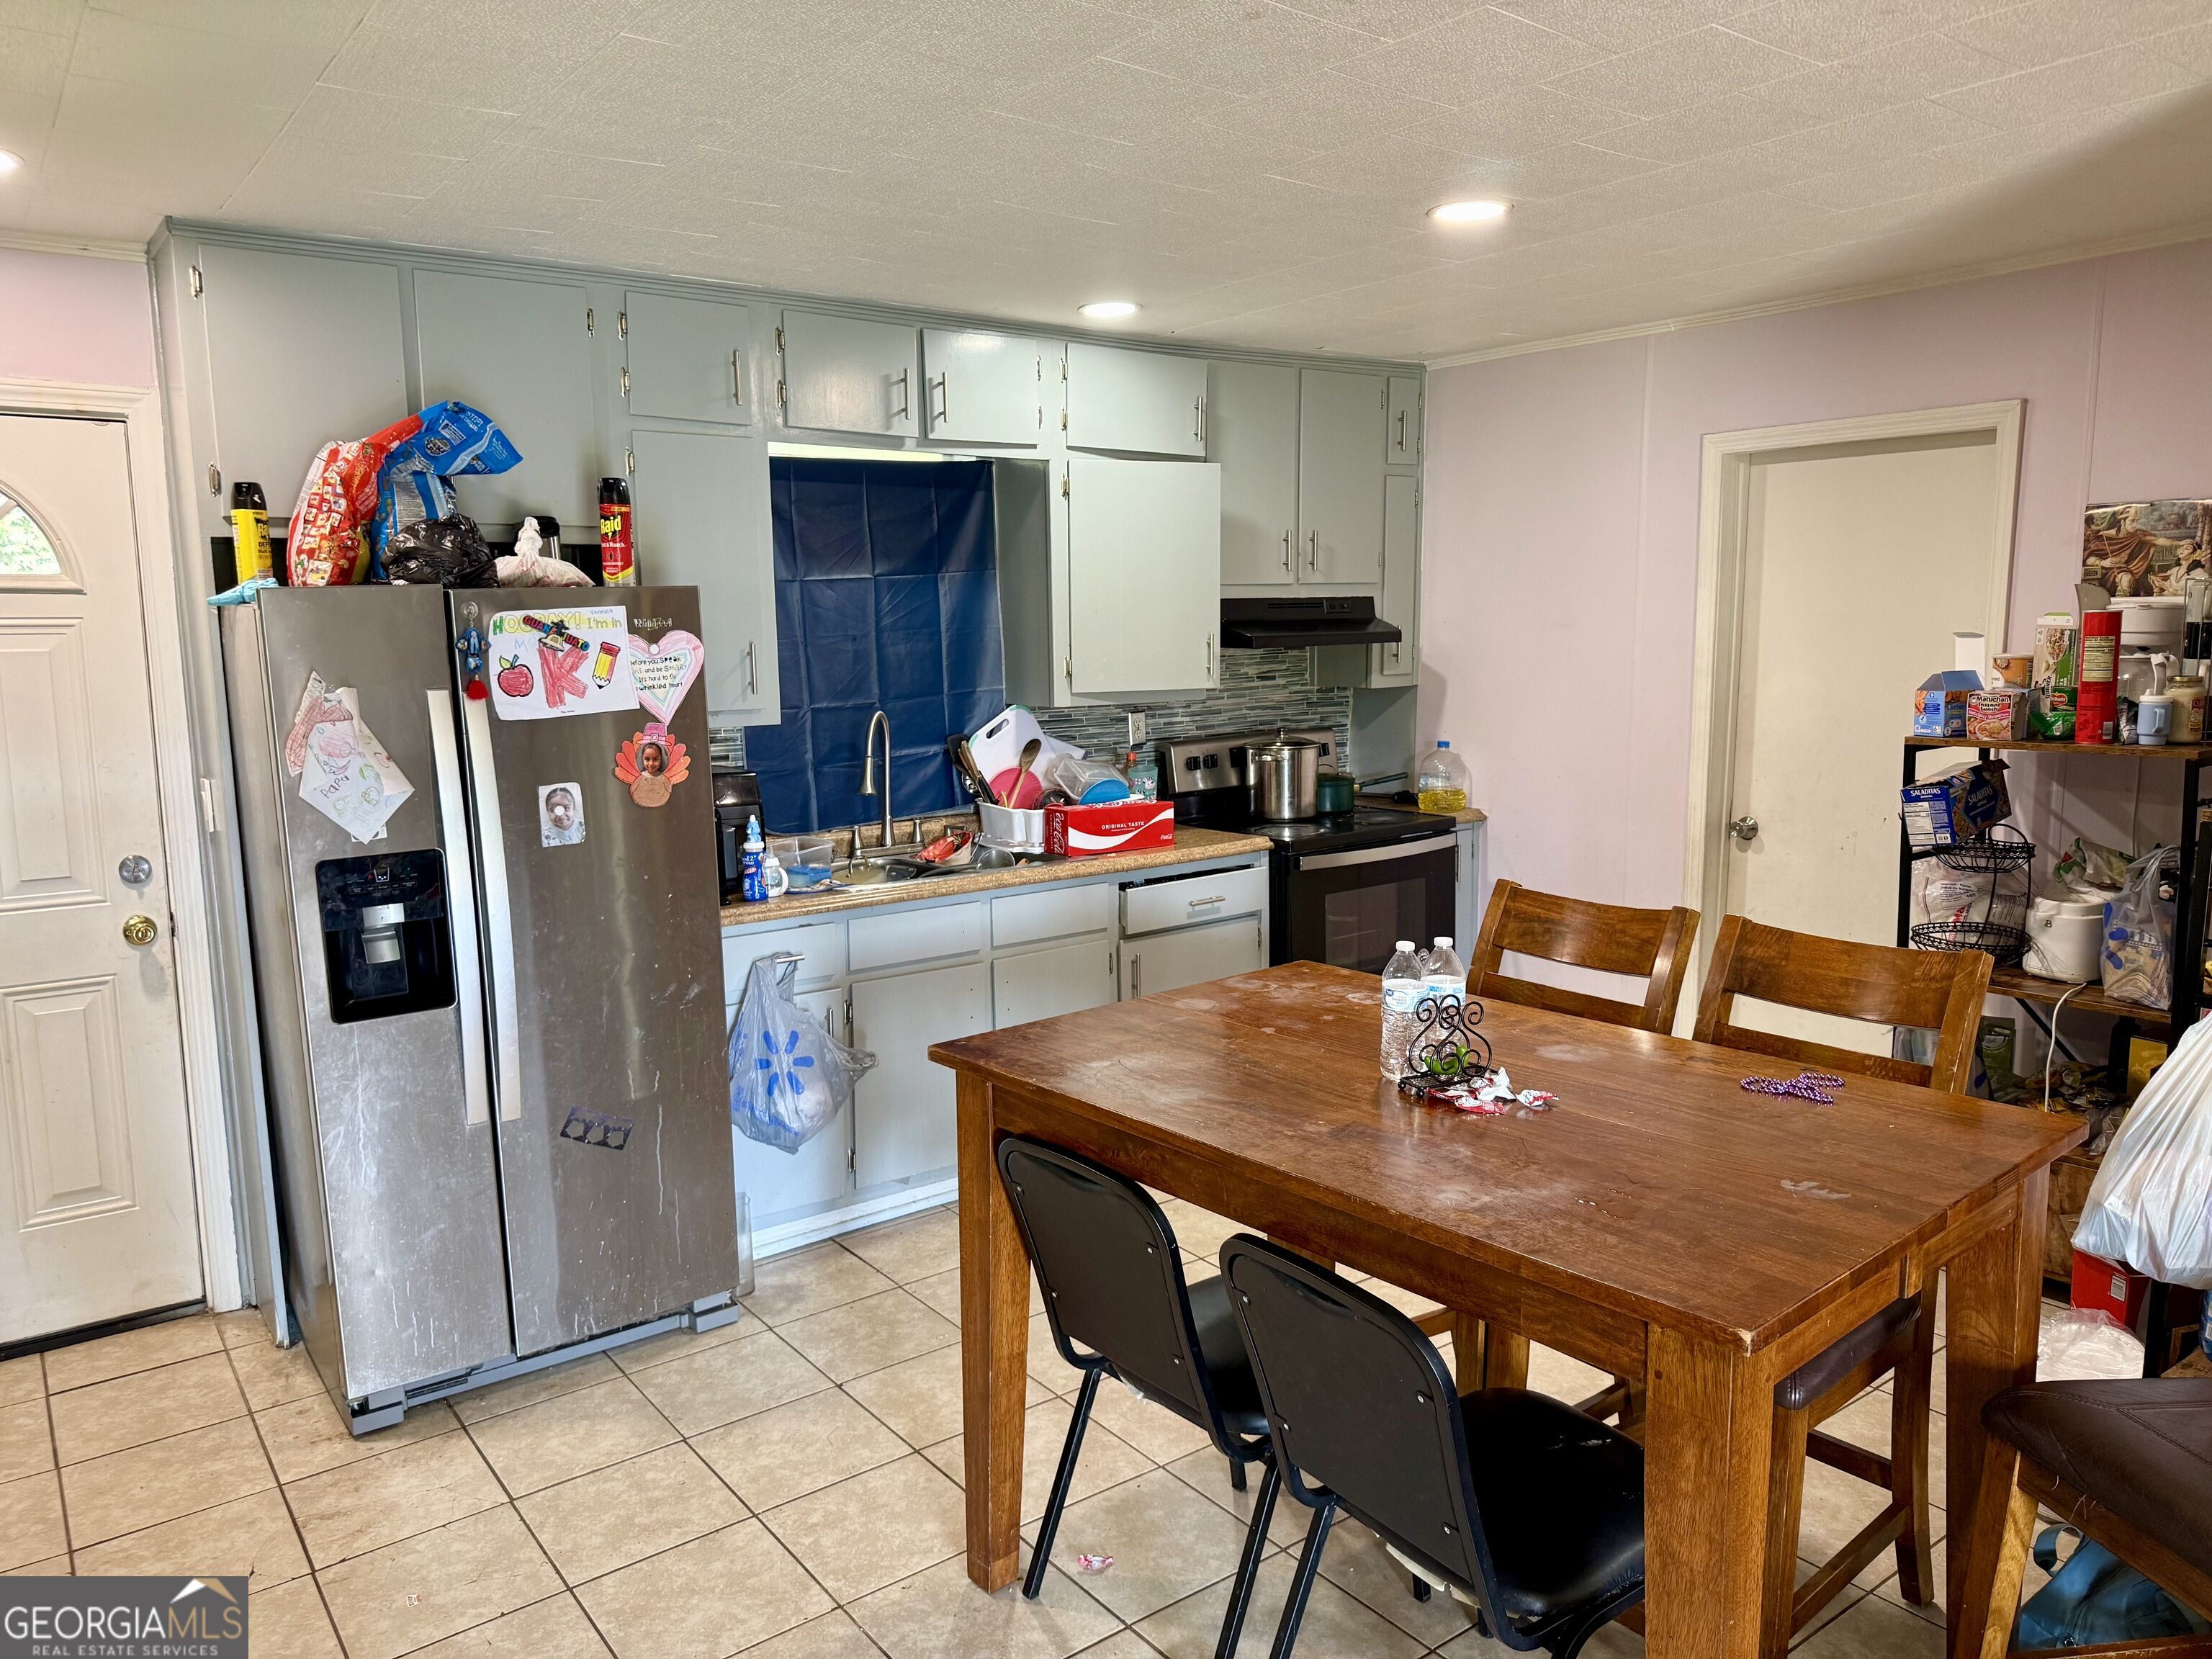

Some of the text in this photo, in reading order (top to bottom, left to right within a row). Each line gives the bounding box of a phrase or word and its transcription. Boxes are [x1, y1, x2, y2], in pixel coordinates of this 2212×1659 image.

[601, 515, 622, 534] Raid
[1910, 788, 1941, 797] SALADITAS
[1968, 785, 1993, 806] SALADITAS
